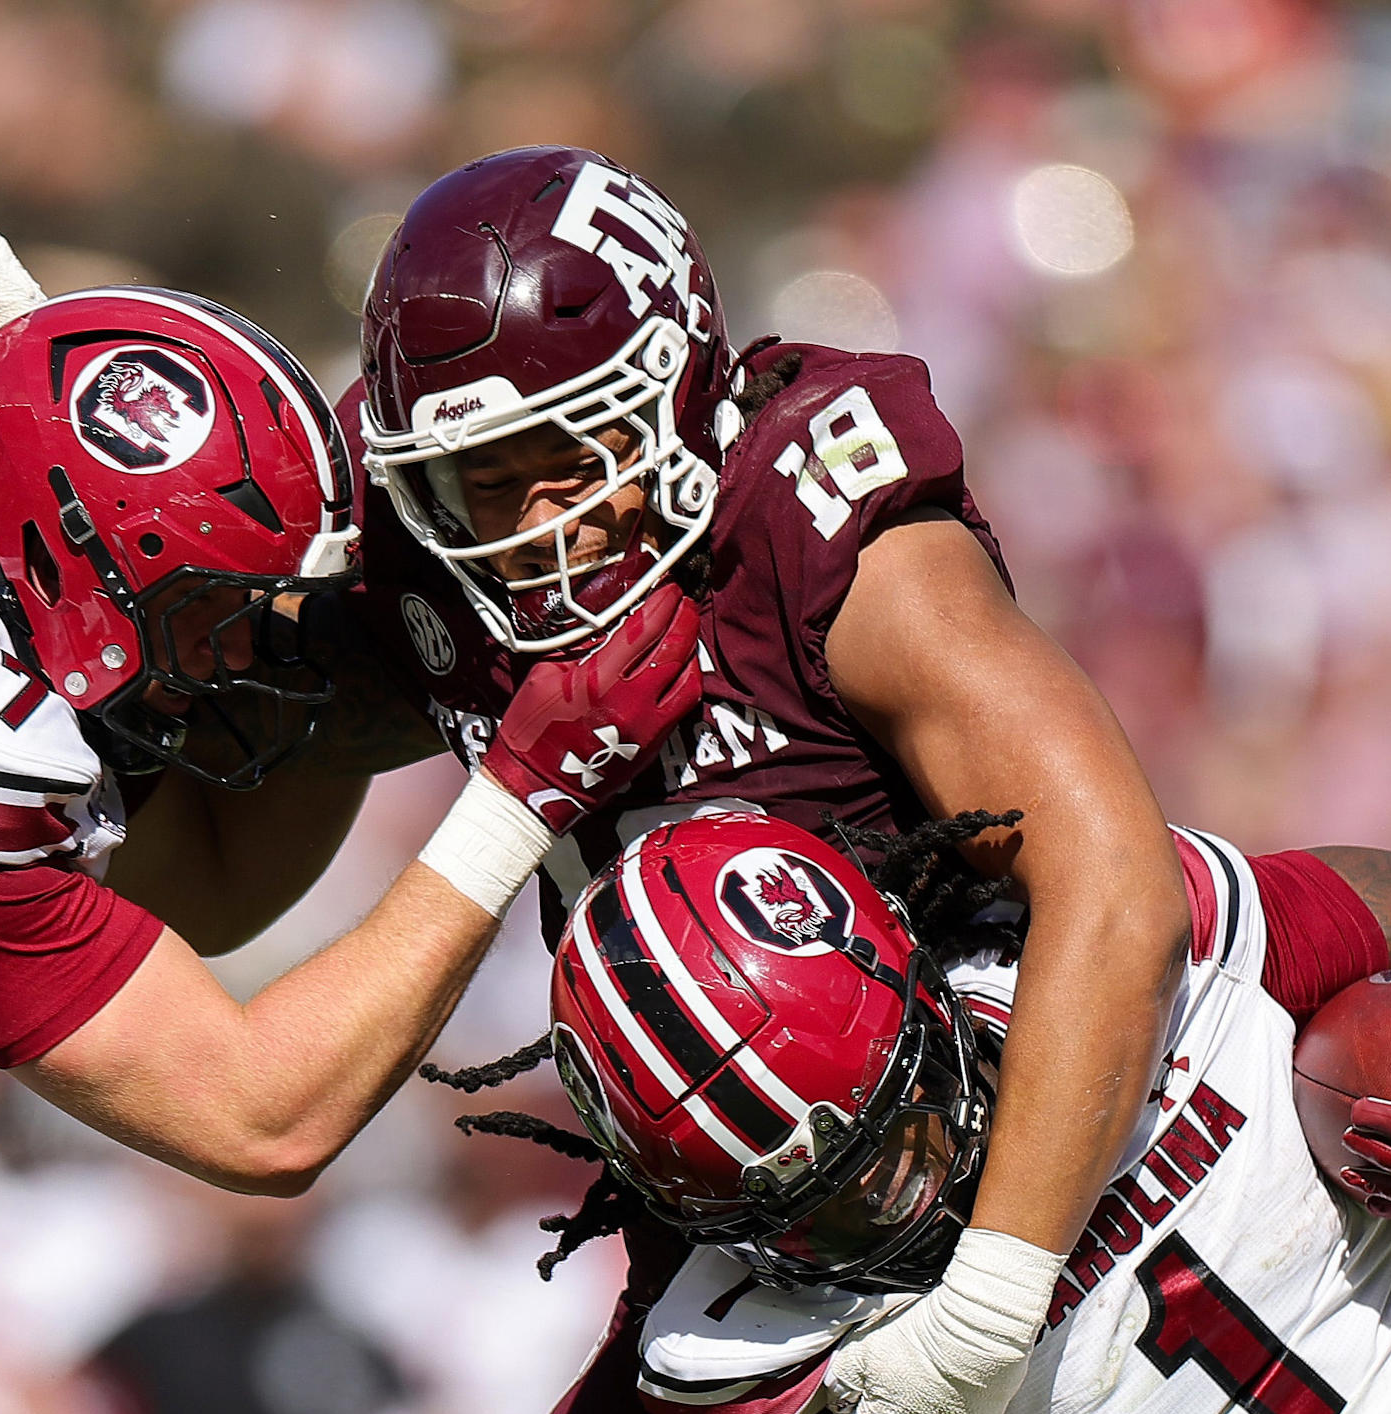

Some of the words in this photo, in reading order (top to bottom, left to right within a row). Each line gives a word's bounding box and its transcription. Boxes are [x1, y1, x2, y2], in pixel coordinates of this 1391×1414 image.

[433, 396, 486, 422] Aggies
[773, 386, 909, 541] 18
[404, 597, 453, 672] SEC
[1034, 1079, 1249, 1347] AROLINA
